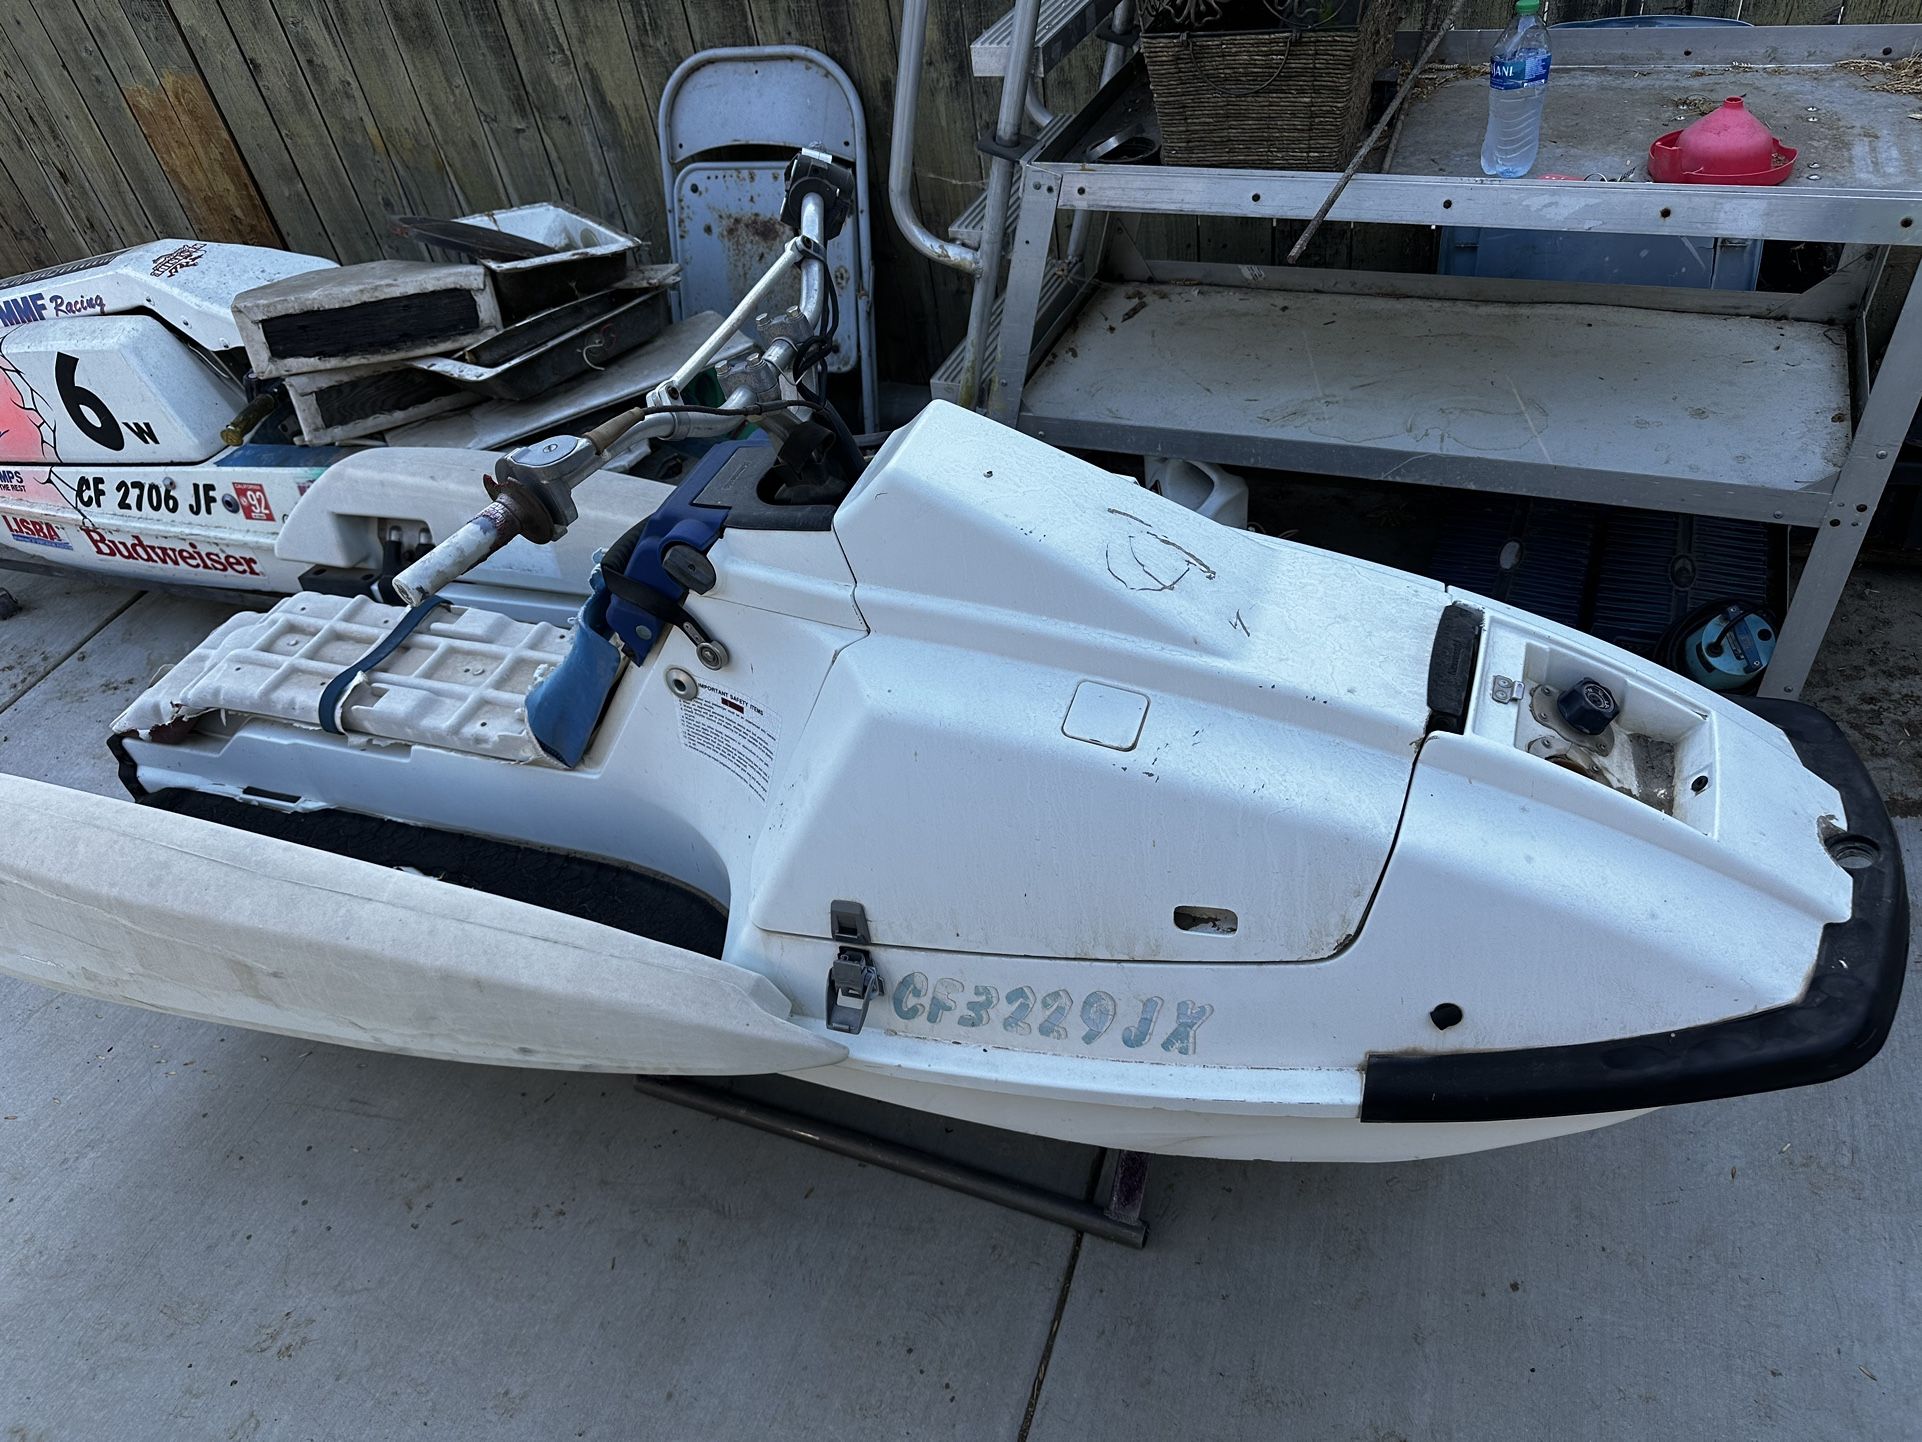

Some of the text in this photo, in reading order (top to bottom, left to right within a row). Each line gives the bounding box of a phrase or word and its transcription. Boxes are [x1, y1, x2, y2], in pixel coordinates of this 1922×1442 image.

[49, 295, 106, 317] Racing
[55, 352, 125, 451] 6
[77, 476, 217, 516] CF 2706 JF
[246, 490, 270, 514] 92
[1, 515, 62, 541] IJSBA
[79, 526, 260, 577] Budweiser
[698, 683, 728, 698] IMPORTANT
[729, 694, 749, 707] SAFETY
[749, 704, 764, 716] ITEMS
